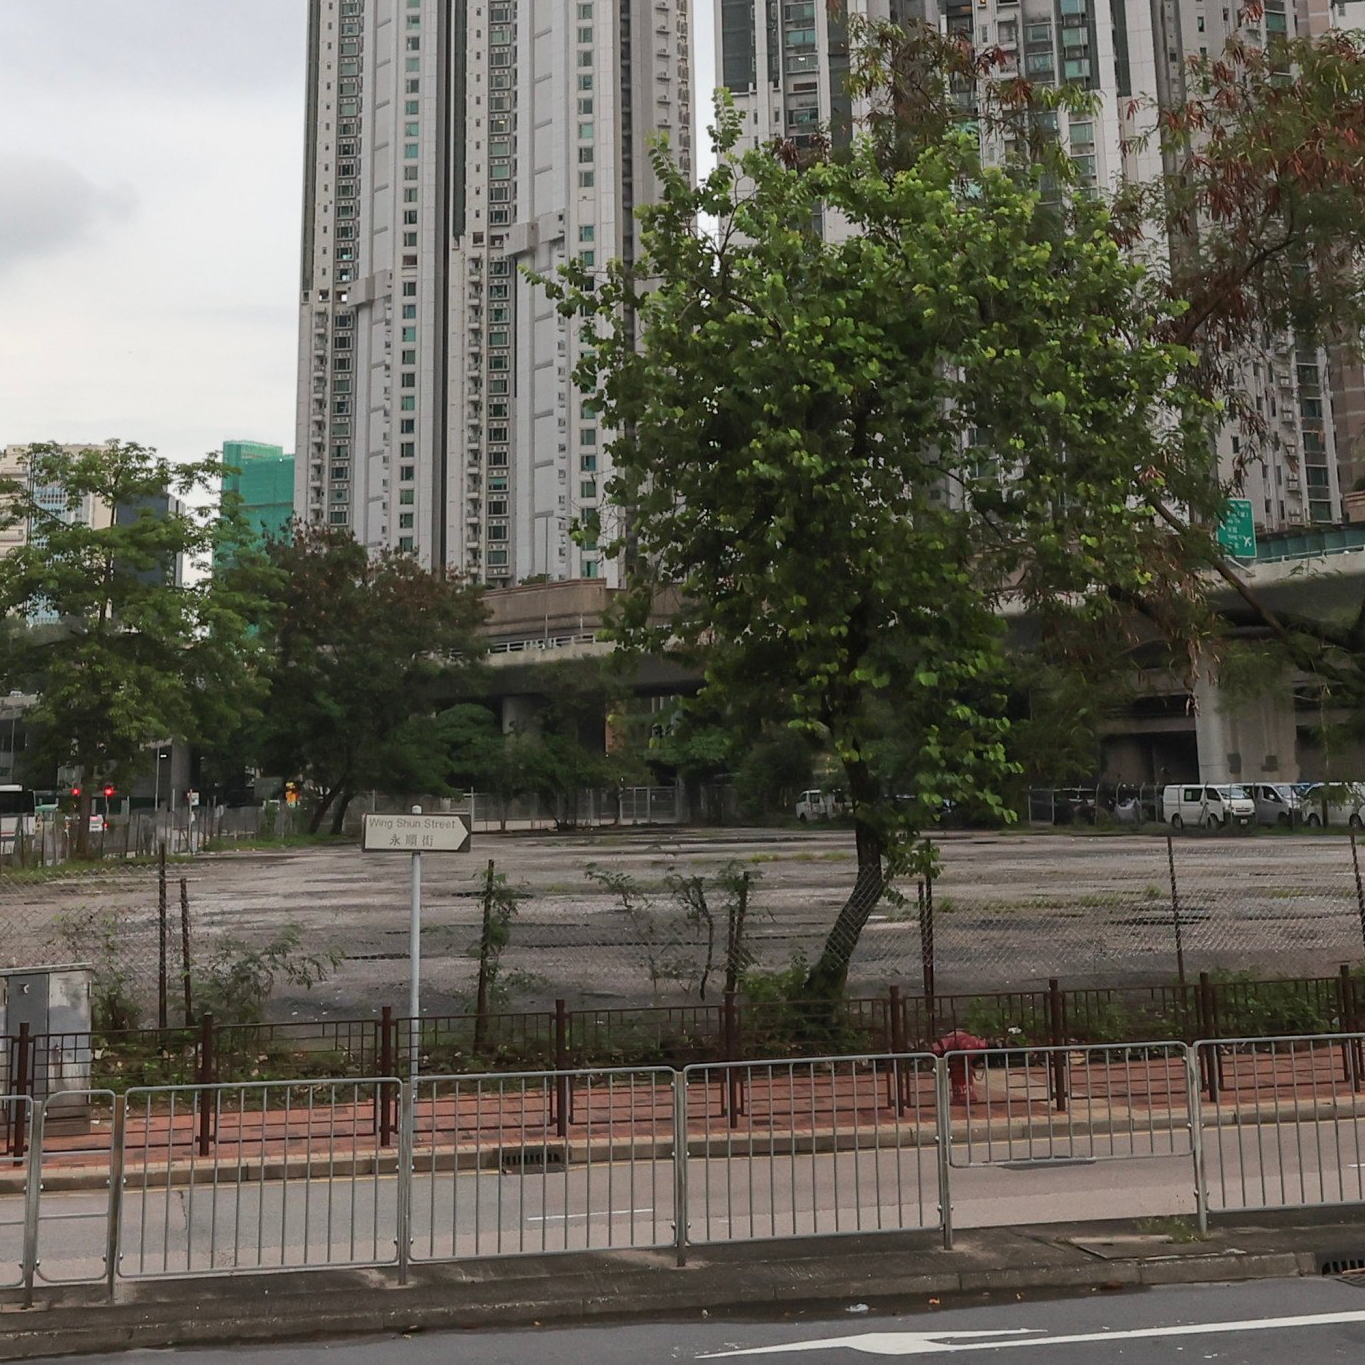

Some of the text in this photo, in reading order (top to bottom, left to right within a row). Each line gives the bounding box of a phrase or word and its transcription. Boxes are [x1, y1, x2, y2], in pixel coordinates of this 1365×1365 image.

[369, 818, 456, 830] Wing Shun Street
[389, 834, 435, 847] 永順街
